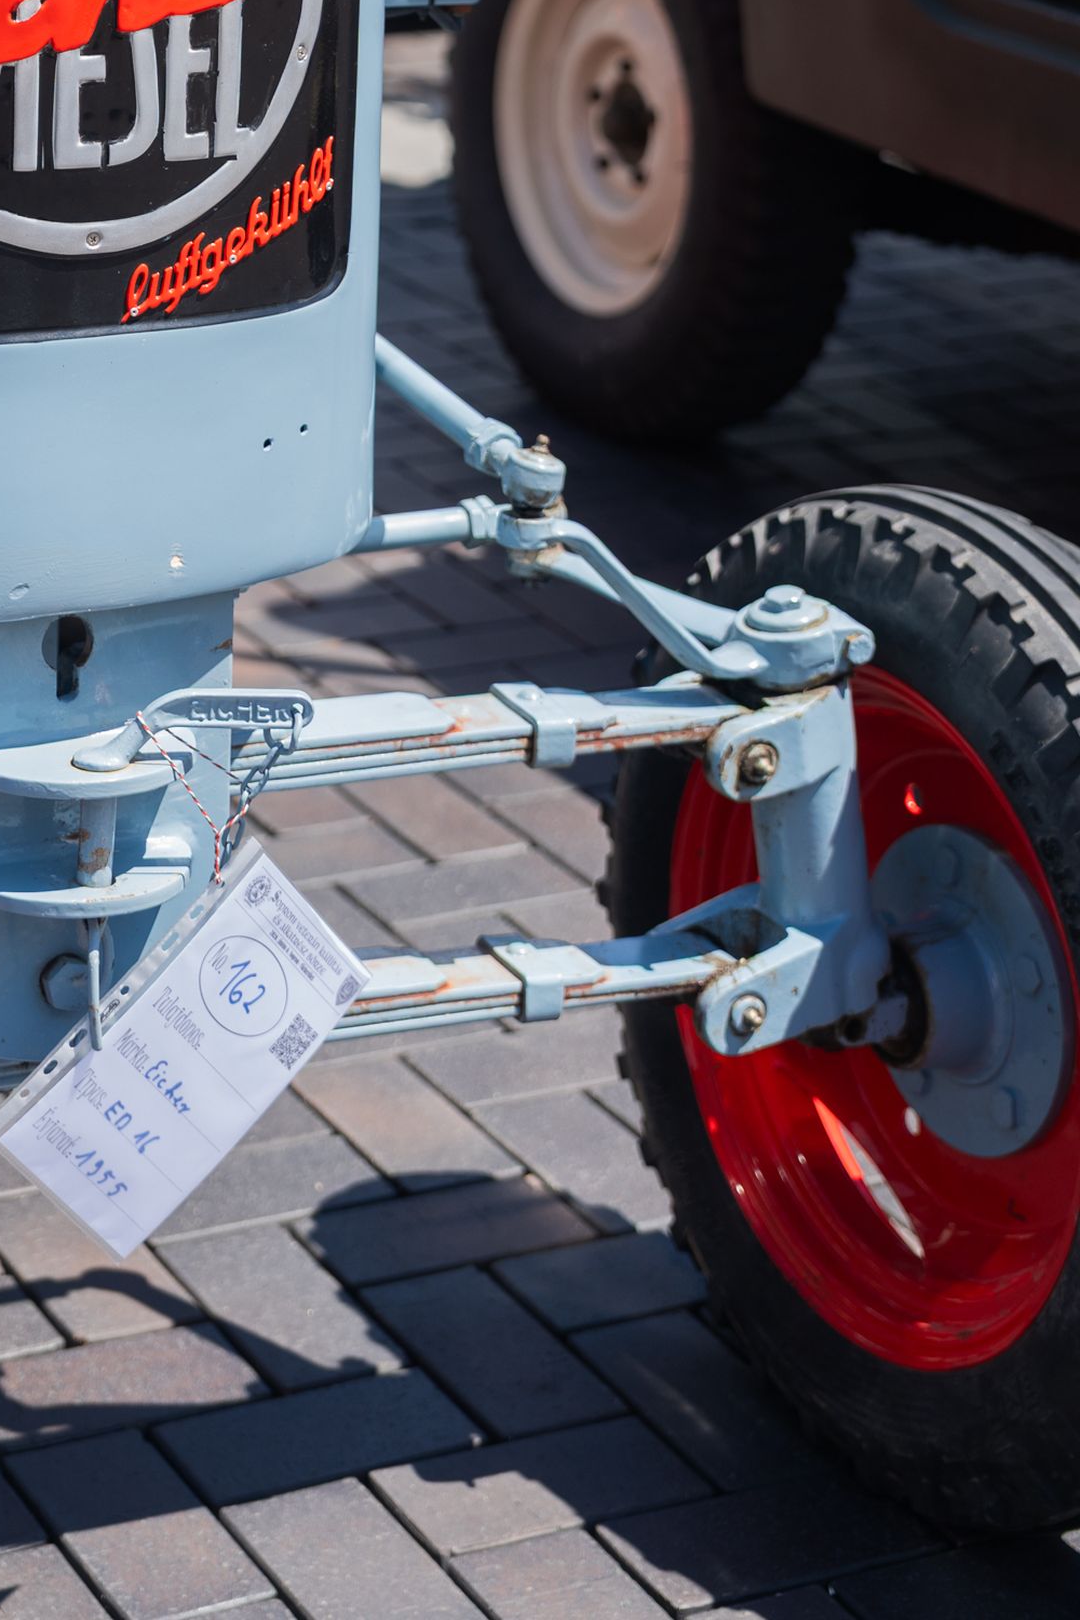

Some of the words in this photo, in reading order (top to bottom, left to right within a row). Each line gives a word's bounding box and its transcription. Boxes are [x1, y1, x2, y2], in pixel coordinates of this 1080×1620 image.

[121, 135, 334, 324] luftgekühlt
[218, 959, 266, 1015] 162
[144, 1060, 191, 1115] Eicher
